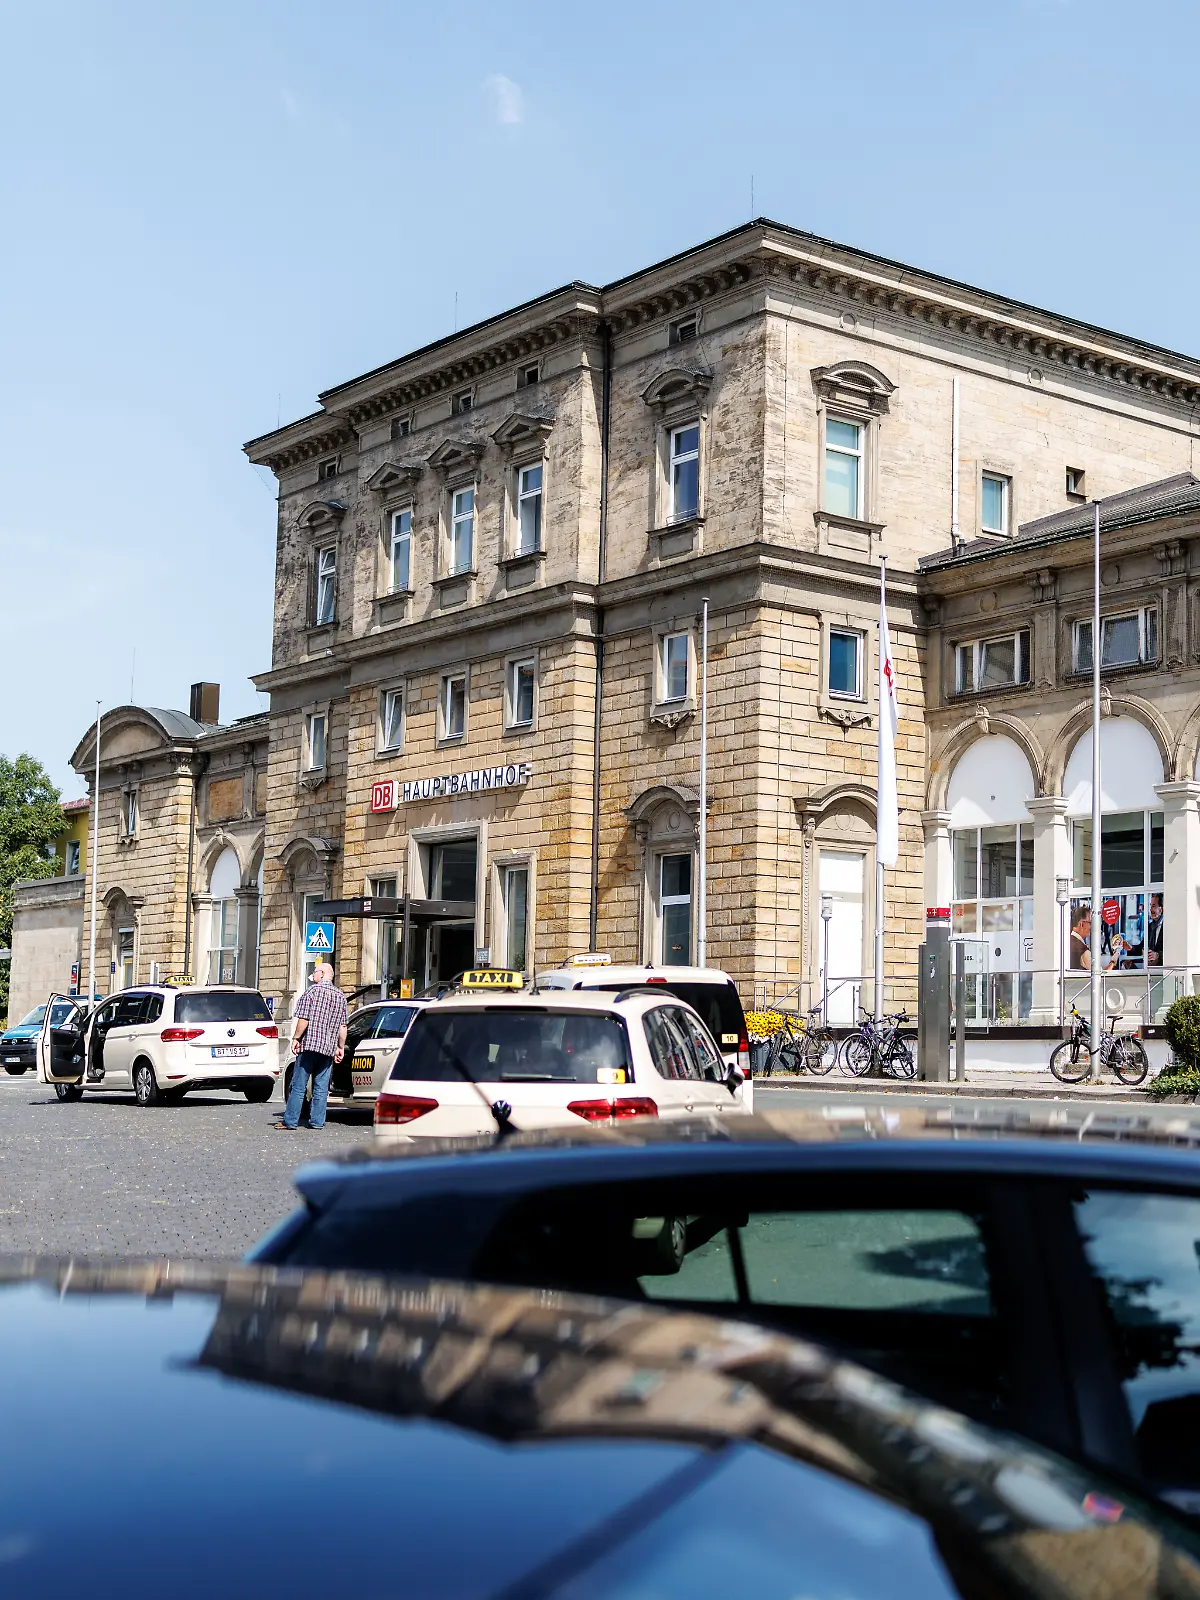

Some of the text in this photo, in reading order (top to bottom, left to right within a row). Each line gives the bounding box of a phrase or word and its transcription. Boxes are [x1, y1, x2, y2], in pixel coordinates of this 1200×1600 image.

[403, 763, 528, 801] HAUPTBAHNHOF
[374, 785, 391, 807] DB
[474, 973, 508, 983] TAXI
